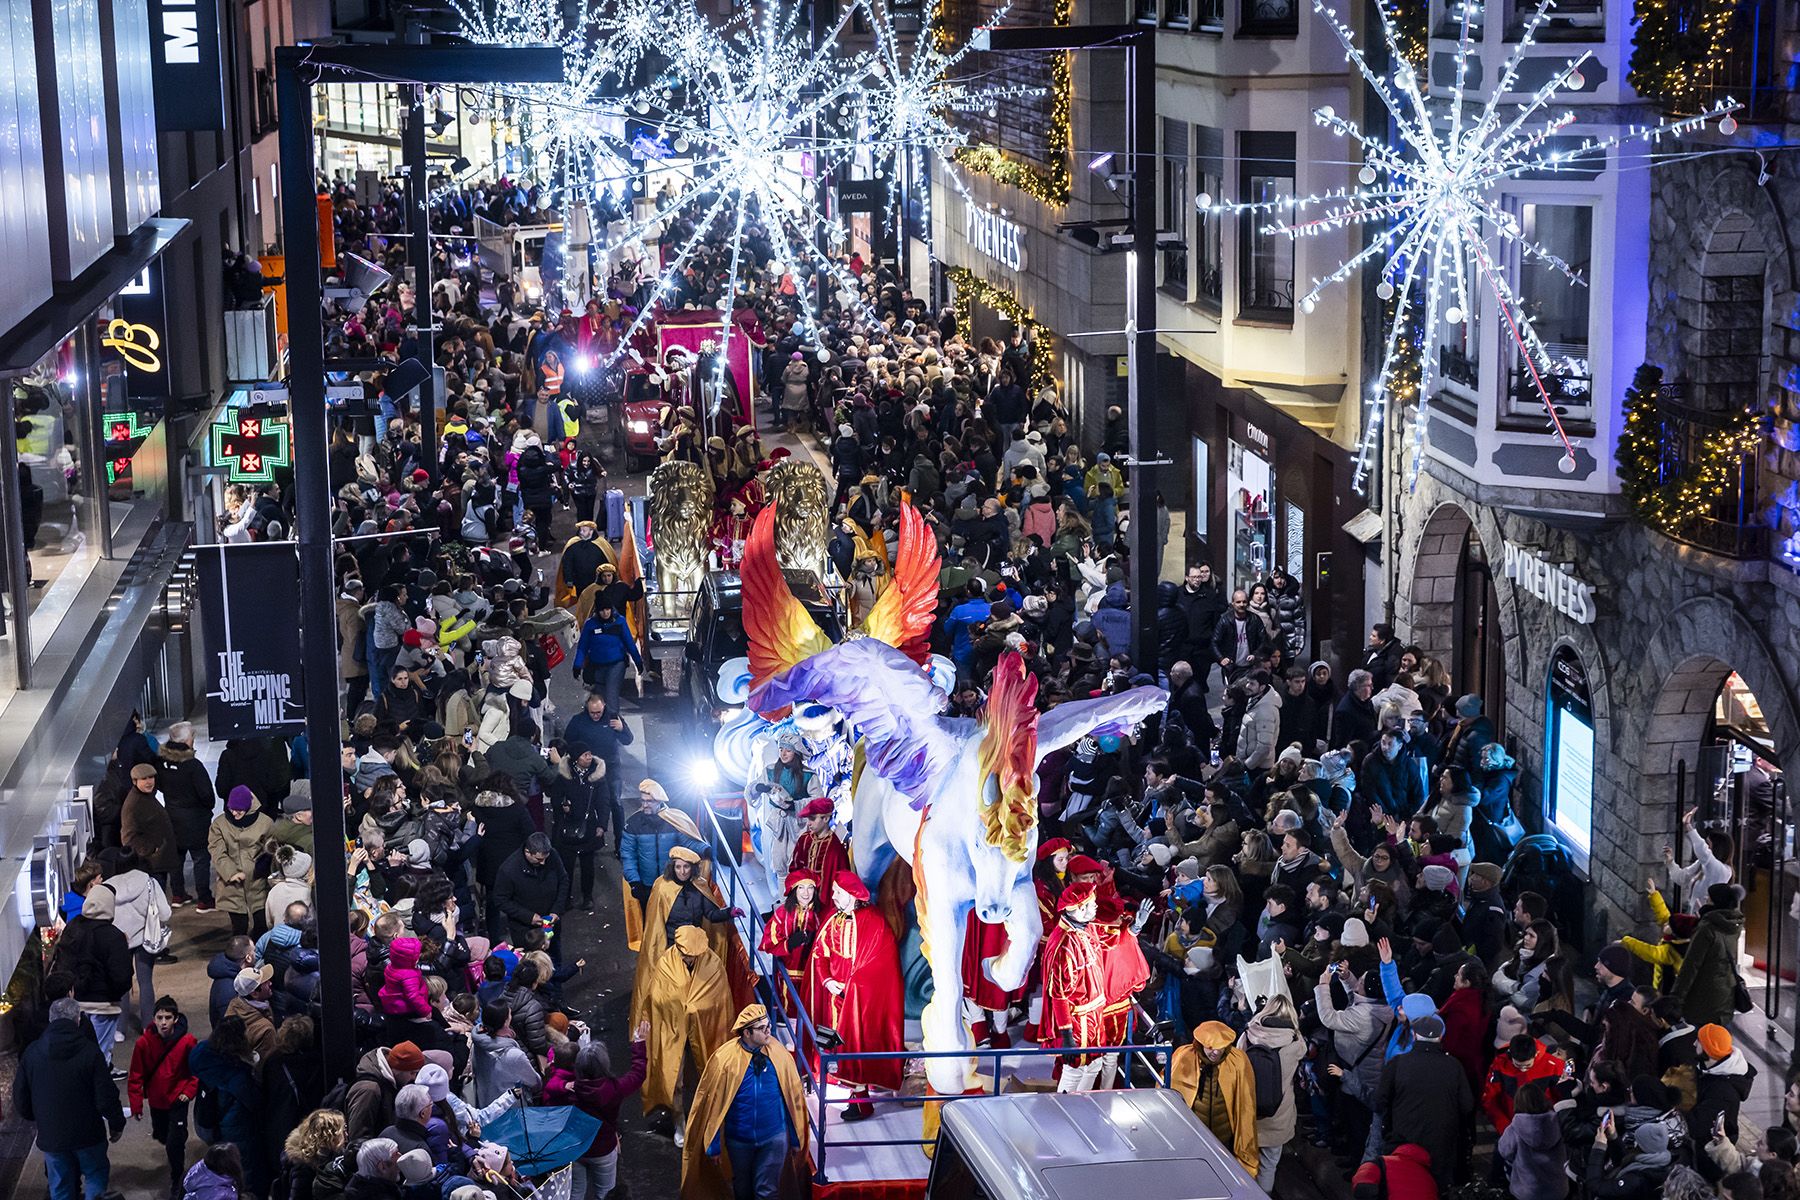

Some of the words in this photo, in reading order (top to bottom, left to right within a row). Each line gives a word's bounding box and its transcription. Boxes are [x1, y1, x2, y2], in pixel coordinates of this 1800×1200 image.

[217, 651, 245, 677] THE
[219, 674, 291, 702] SHOPPING
[254, 699, 286, 724] MILE
